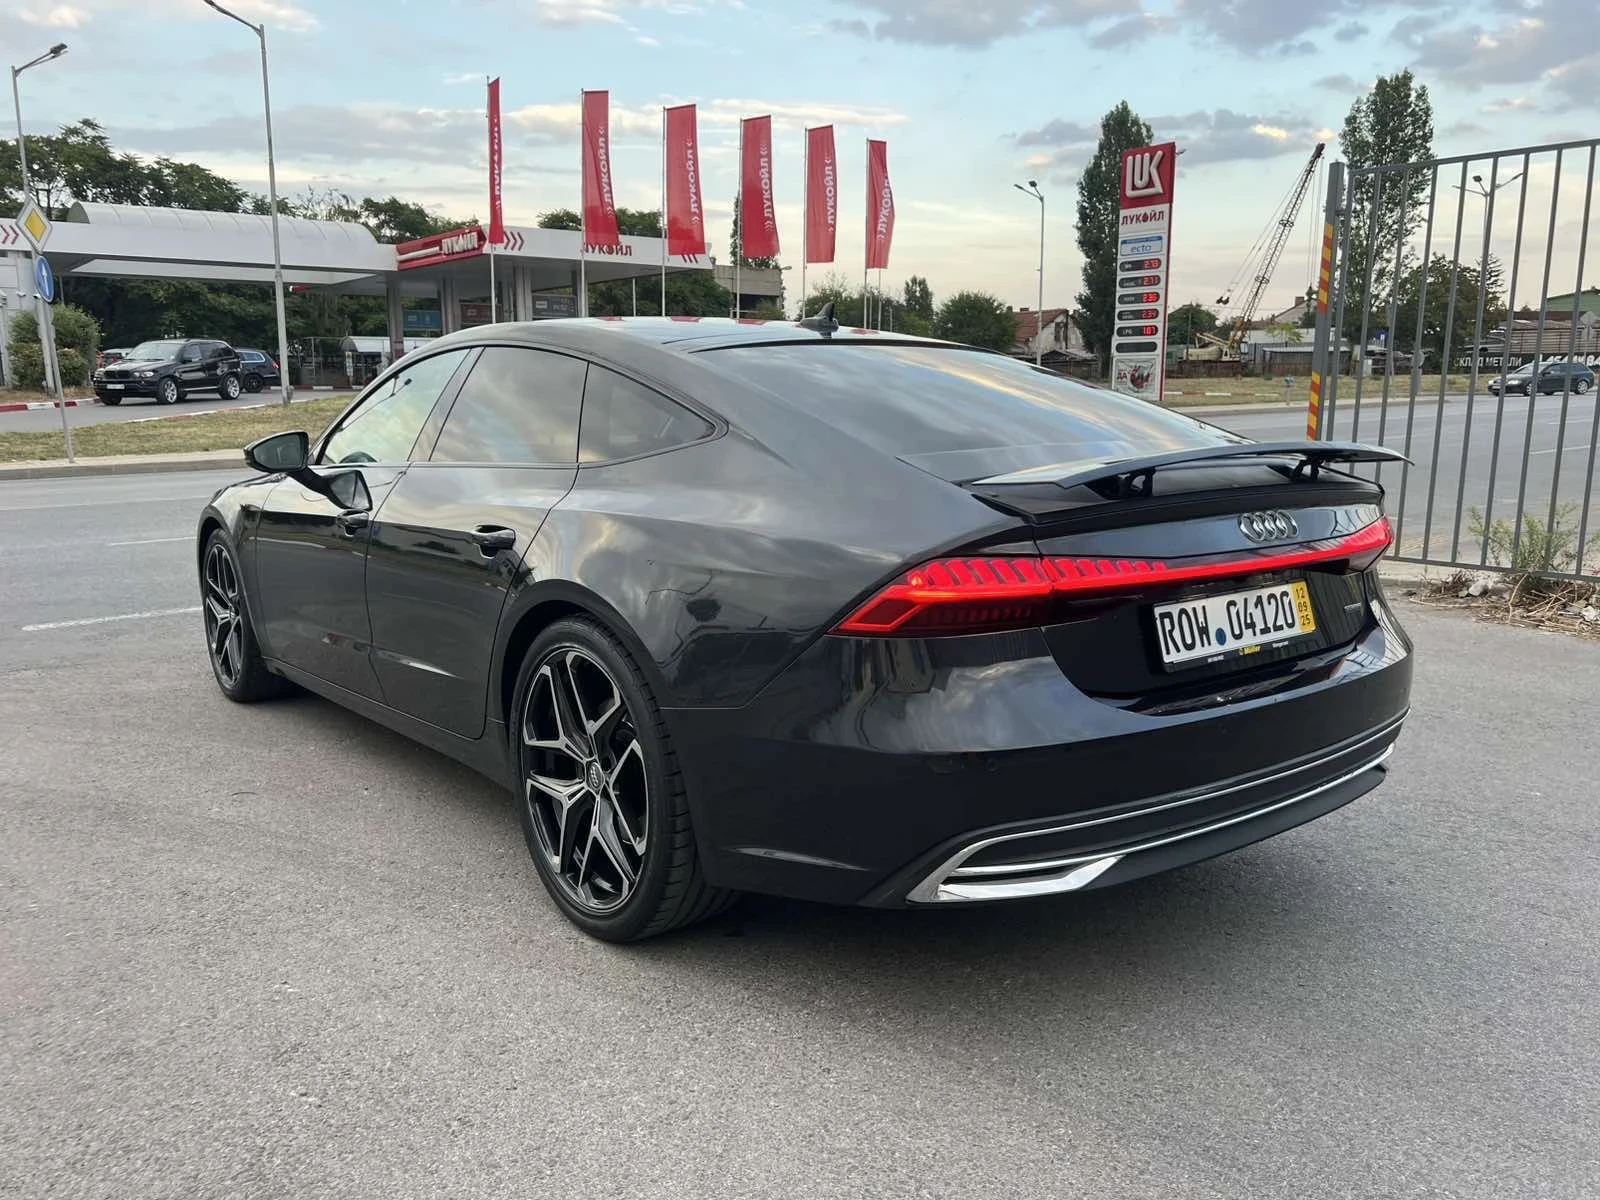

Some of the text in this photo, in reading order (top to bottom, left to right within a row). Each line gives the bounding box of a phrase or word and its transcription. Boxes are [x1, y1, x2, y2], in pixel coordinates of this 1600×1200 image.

[597, 137, 614, 204] ЛУКОЙЛ
[685, 149, 701, 214] ЛУКОЙЛ
[759, 157, 773, 218] ЛУКОЙЛ
[823, 166, 834, 225] ЛУКОЙЛ
[1121, 209, 1164, 226] ЛУКОЙЛ
[1454, 356, 1523, 367] СКЛД МЕТЛИ
[1295, 587, 1306, 599] 12
[1297, 601, 1308, 612] 09
[1159, 590, 1296, 656] ROW 04120
[1300, 613, 1311, 626] 25
